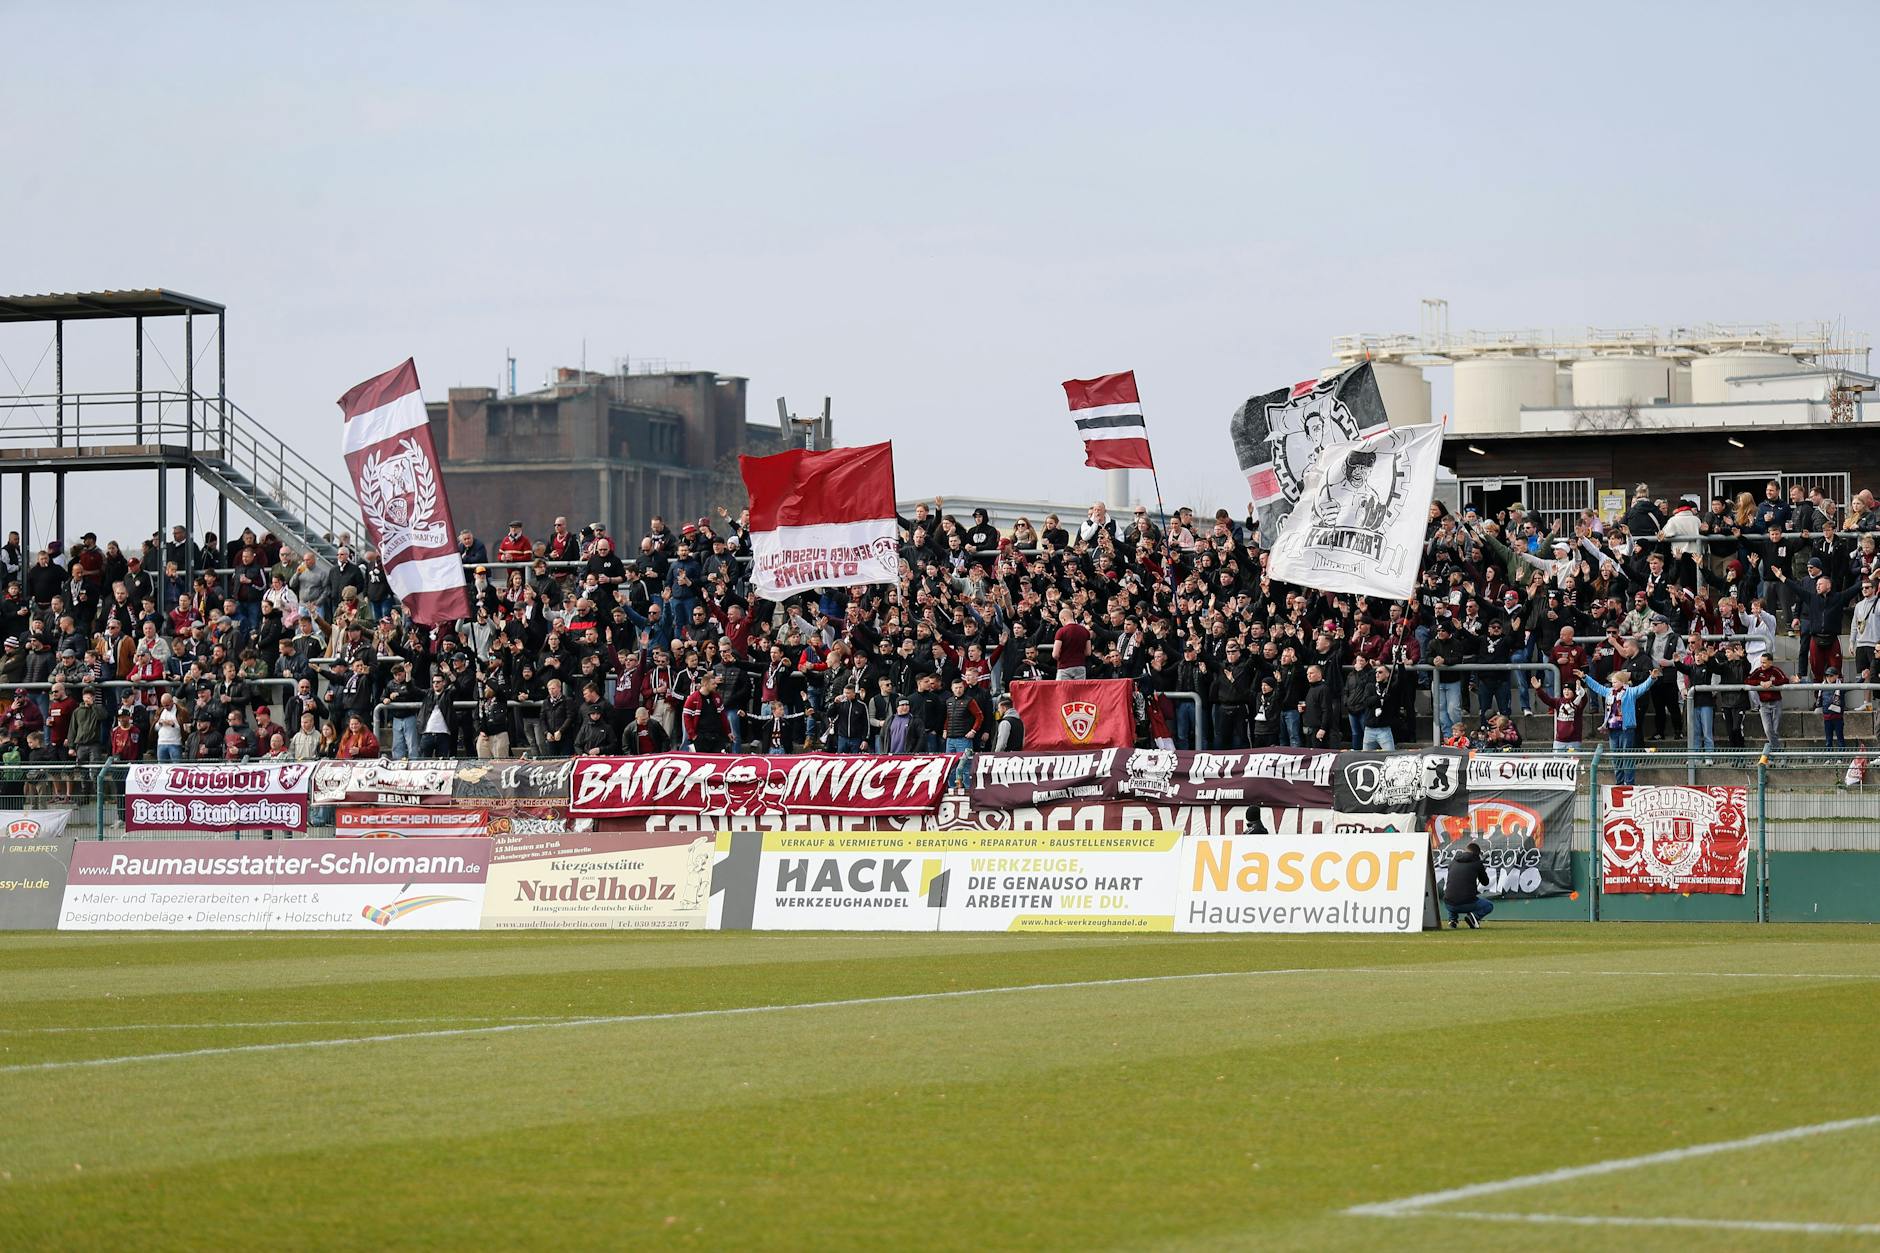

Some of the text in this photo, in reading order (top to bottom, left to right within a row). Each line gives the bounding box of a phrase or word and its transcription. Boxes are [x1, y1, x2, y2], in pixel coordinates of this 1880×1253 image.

[1063, 704, 1095, 716] BFC
[410, 761, 458, 770] FAMILIE
[1188, 753, 1338, 786] OST BERLIN
[168, 766, 269, 791] Division
[573, 757, 946, 805] BANDA INVICTA
[378, 794, 421, 804] BERLIN
[1632, 789, 1716, 820] TRUPPE
[133, 799, 301, 827] Berlin Brandenburg
[360, 814, 430, 824] DEUTSCHER
[431, 814, 481, 824] MEISTER
[9, 822, 37, 833] BFC
[9, 845, 58, 853] GRILLBUFFETS
[545, 841, 560, 849] Fuß
[781, 839, 1155, 847] VERKAUF & VERMIETUNG BERATUNG REPARATUR BAUSTELLENSERVICE
[79, 852, 480, 876] www.Raumausstatter-Schlomann.de
[551, 859, 645, 873] Kiezgaststätte
[971, 858, 1085, 874] WERKZEUGE,
[1192, 840, 1415, 892] Nascor
[776, 858, 912, 892] HACK
[1605, 876, 1631, 884] BOCHUM
[514, 876, 676, 902] Nudelholz
[968, 877, 1143, 891] DIE GENAUSO HART
[82, 893, 320, 907] Maler- und Tapezierarbeiten Parkett &
[775, 897, 909, 908] WERKZEUGHANDEL
[965, 895, 1129, 909] ARBEITEN WIE DU.
[532, 903, 653, 913] Hausgemachte deutsche Küche
[1189, 900, 1411, 930] Hausverwaltung
[65, 912, 353, 924] Designbodenbeläge Dielenschliff Holzschutz
[496, 919, 608, 928] www.nudelholz-berlin.com
[617, 919, 632, 928] Tel.
[634, 920, 649, 928] 030
[1021, 918, 1148, 927] www.hack-werkzeughandel.de
